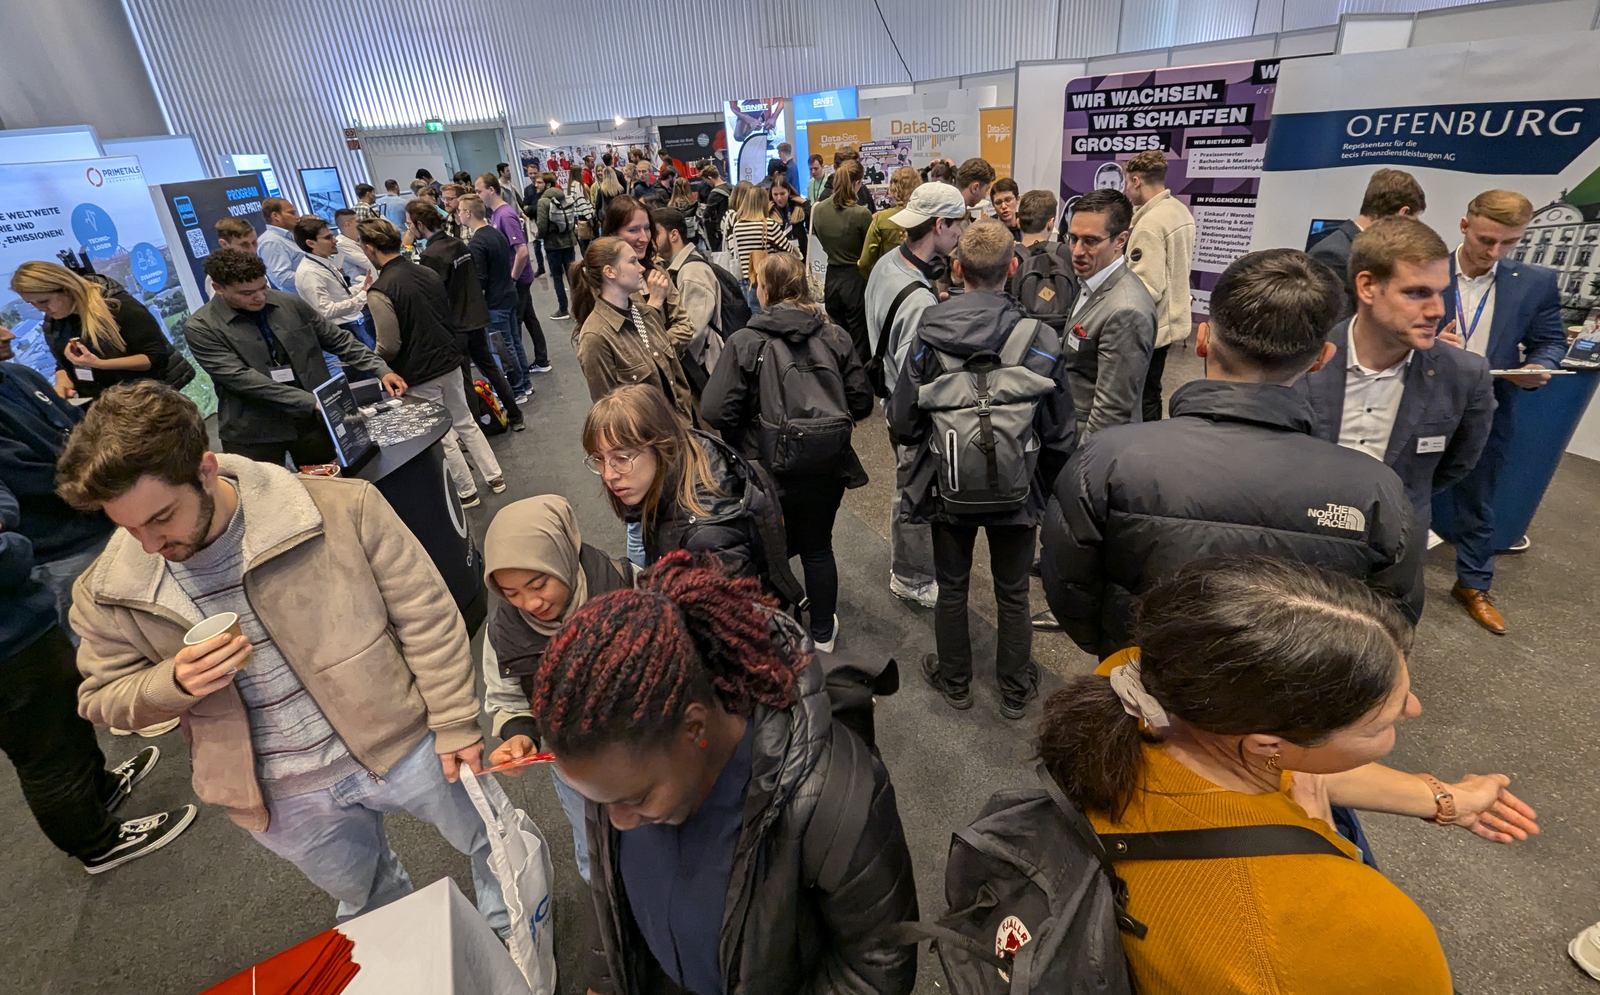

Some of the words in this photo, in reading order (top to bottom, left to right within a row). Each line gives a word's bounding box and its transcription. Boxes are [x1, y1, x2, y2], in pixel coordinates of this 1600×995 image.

[1261, 63, 1280, 80] W
[813, 96, 834, 106] ERNST
[1072, 93, 1106, 109] WIR
[1111, 83, 1218, 106] WACHSEN.
[740, 103, 768, 112] ERNST
[1093, 114, 1128, 130] WIR
[1133, 107, 1248, 128] SCHAFFEN
[1346, 107, 1585, 137] OFFENBURG
[890, 116, 956, 135] Data-Sec
[987, 123, 1010, 134] Data-Sec
[821, 133, 858, 143] Data-Sec
[1075, 135, 1165, 151] GROSSES.
[1342, 141, 1393, 151] Repräsentanz
[1360, 149, 1443, 160] Finanzdienstleistungen
[1443, 153, 1456, 161] AG
[102, 166, 141, 177] PRIMETALS
[226, 186, 260, 201] PROGRAM
[6, 207, 61, 220] WELTWEITE
[227, 203, 248, 217] YOUR
[247, 201, 262, 216] PATH
[0, 224, 14, 233] RIE
[13, 222, 35, 231] UND
[88, 235, 111, 244] TECHNO-
[93, 243, 112, 251] LOGIEN
[1213, 246, 1249, 254] Managemen
[1198, 251, 1232, 259] Intralogistik
[140, 270, 164, 281] ZUSAMMEN-
[147, 277, 162, 286] ARBEIT
[1326, 503, 1349, 514] THE
[1307, 508, 1348, 522] NORTH
[1316, 518, 1346, 529] FACE
